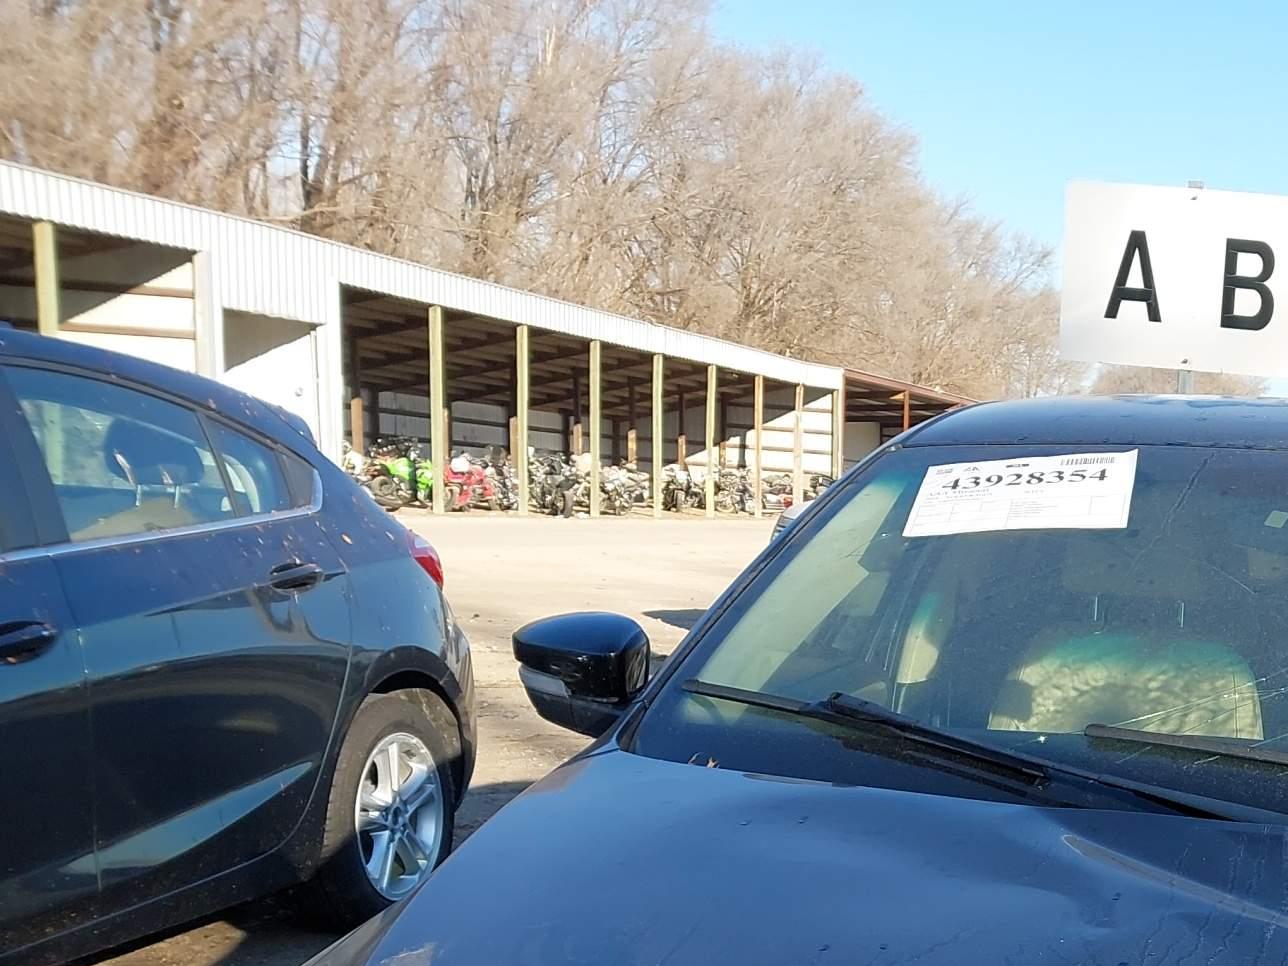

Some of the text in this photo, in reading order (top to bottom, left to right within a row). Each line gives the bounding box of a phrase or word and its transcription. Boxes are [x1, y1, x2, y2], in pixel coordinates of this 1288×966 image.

[1103, 229, 1276, 332] A B
[941, 468, 1109, 490] 43928354
